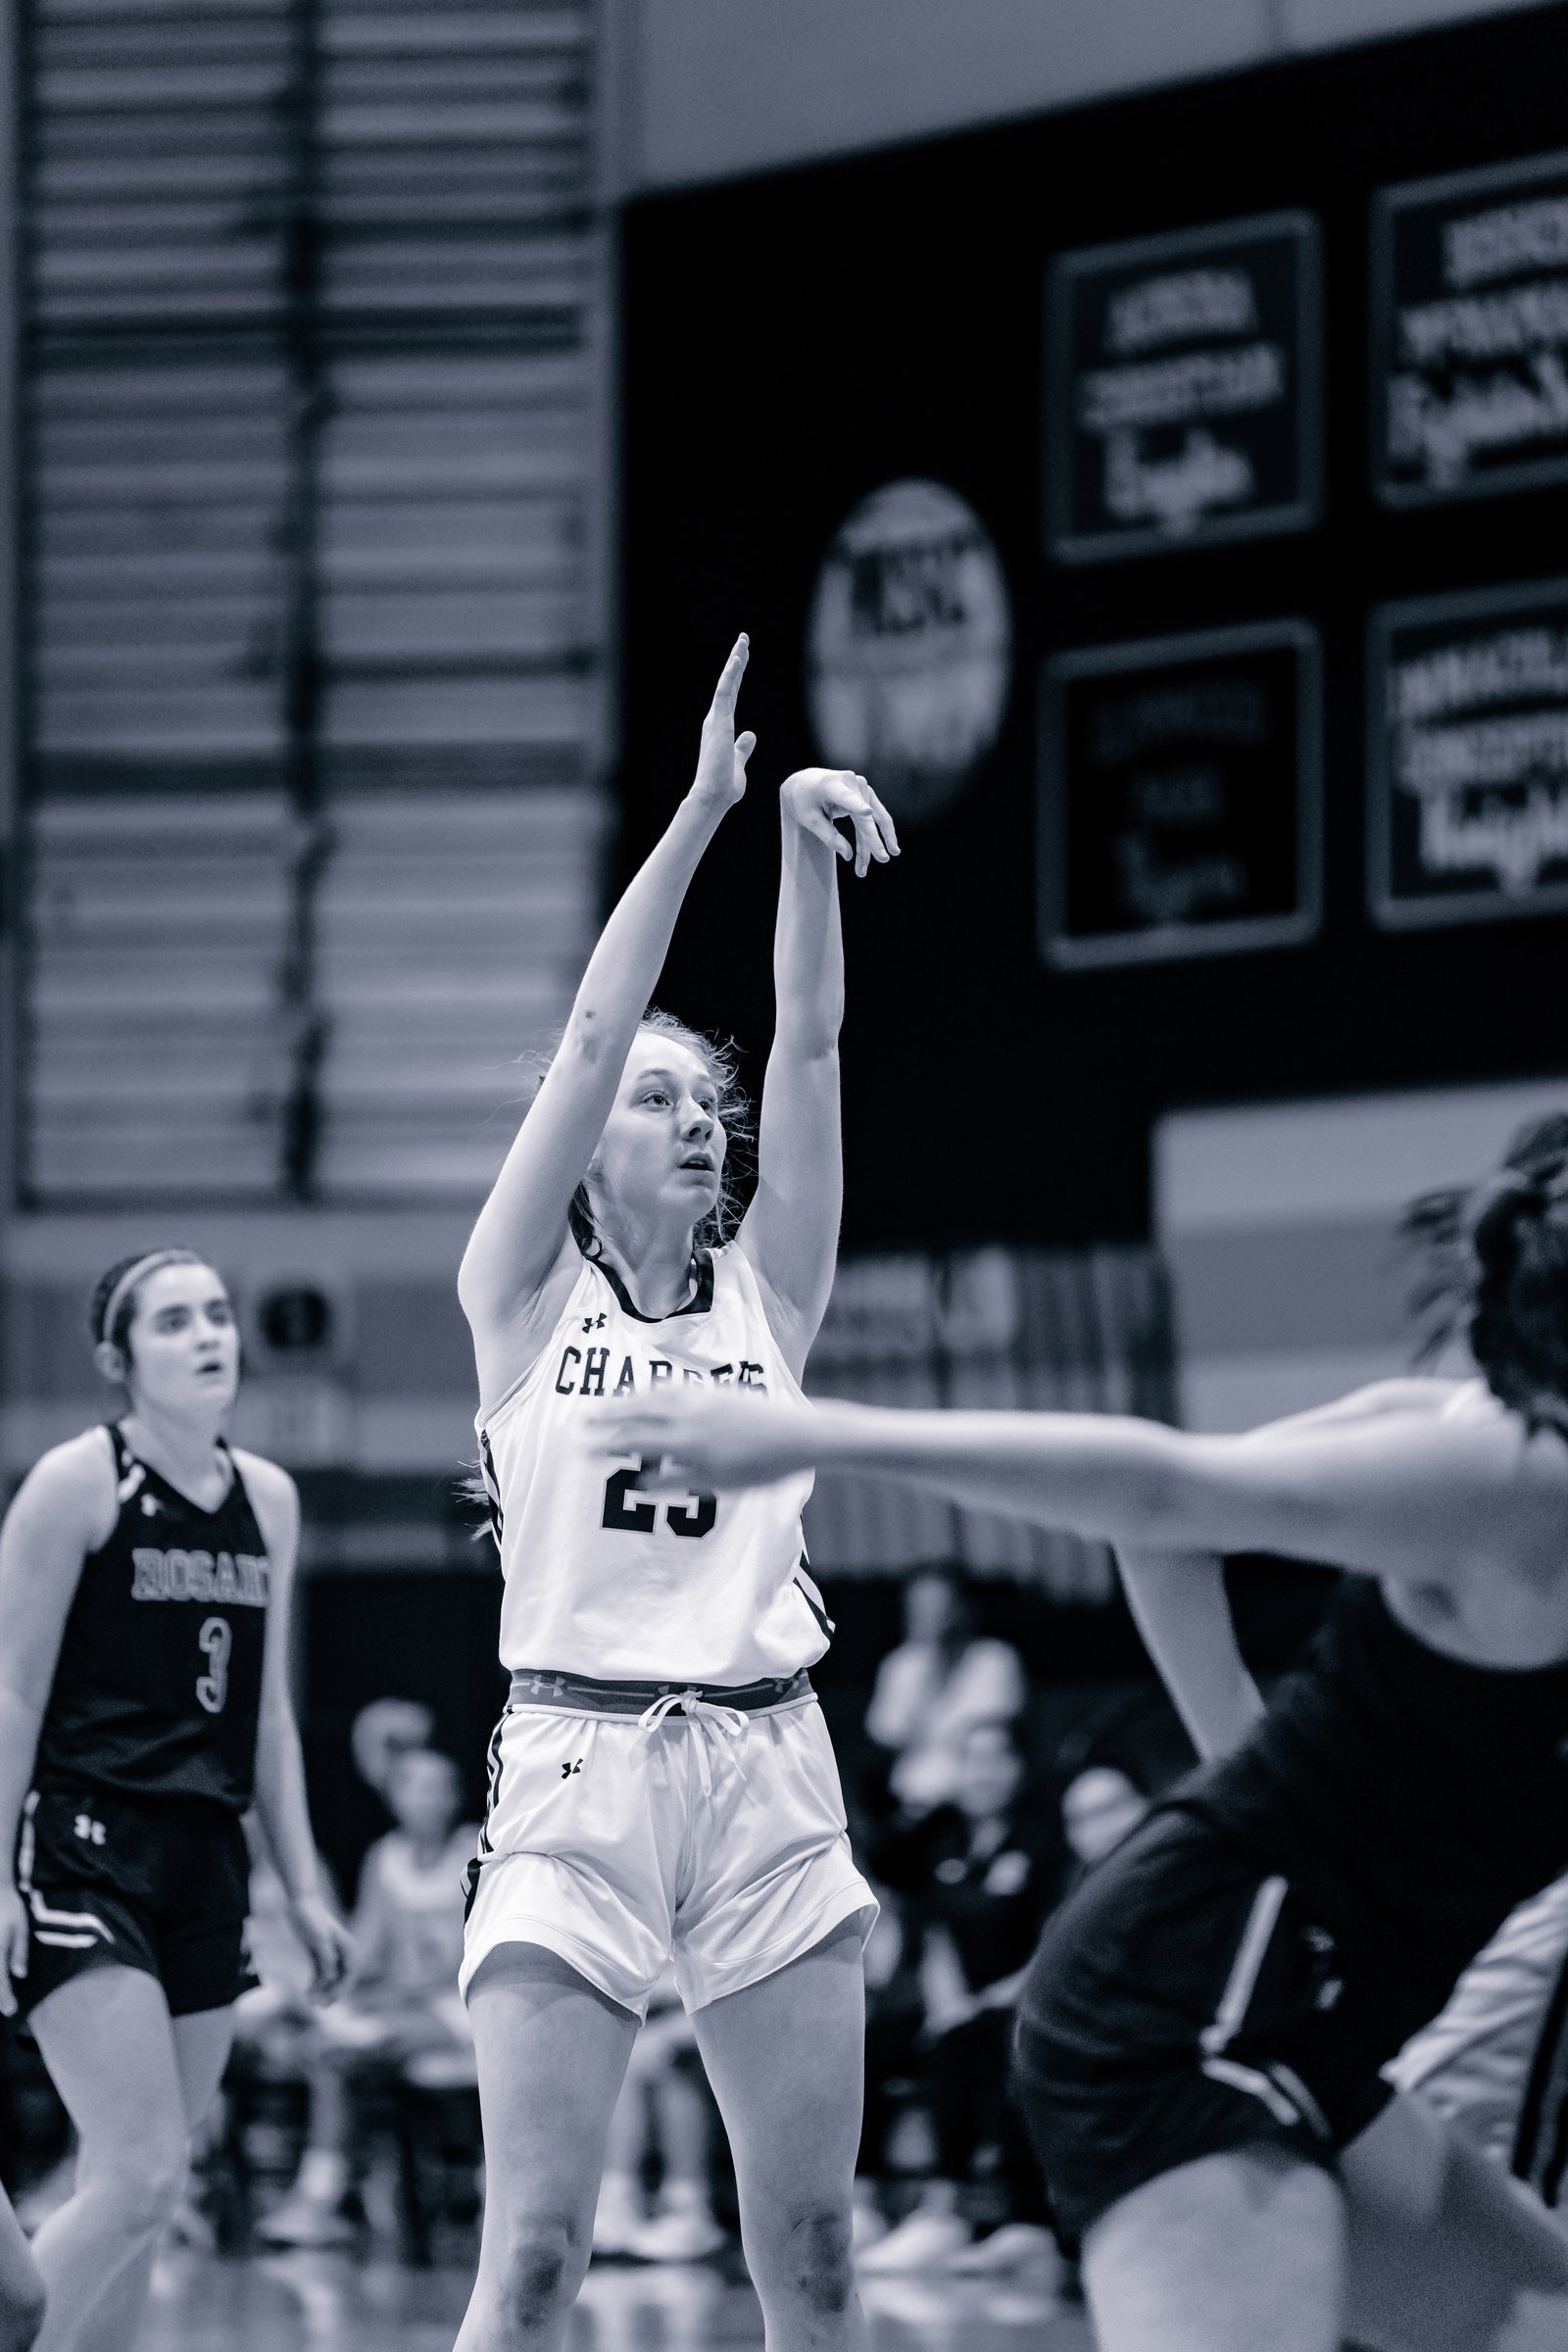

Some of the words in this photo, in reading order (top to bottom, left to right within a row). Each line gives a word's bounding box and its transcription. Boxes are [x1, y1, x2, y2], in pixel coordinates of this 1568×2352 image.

[600, 1450, 718, 1540] 23
[130, 1547, 270, 1608] ROSAR
[196, 1617, 232, 1714] 3
